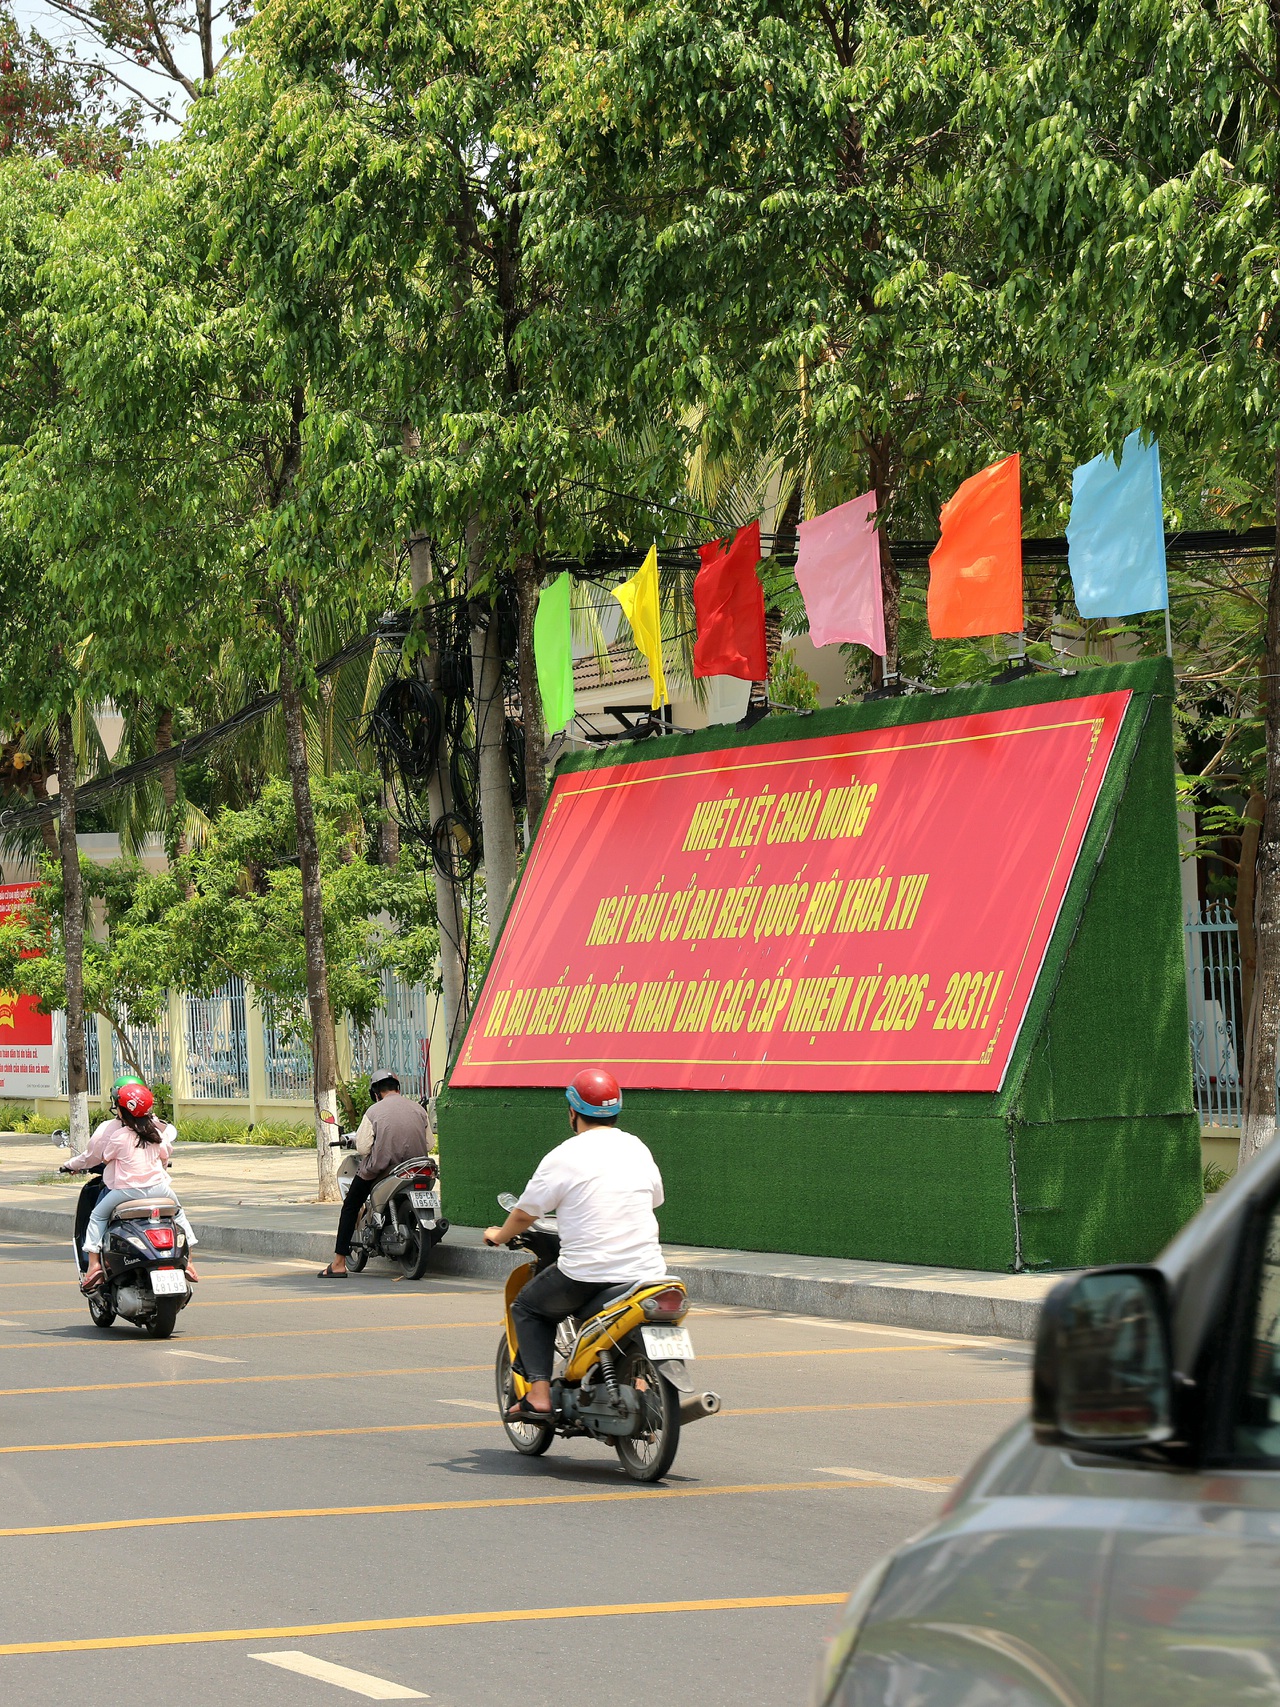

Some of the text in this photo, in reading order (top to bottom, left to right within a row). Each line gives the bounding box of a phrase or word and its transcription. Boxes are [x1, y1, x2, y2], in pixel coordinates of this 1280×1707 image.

[681, 775, 878, 861] NHIỆT LIỆT CHÀO MỪNG
[585, 885, 635, 946] NGÀY
[625, 875, 669, 943] BẦU
[659, 873, 697, 941] CỬ
[682, 888, 722, 951] ĐẠI
[712, 864, 763, 938] BIỂU
[754, 864, 810, 943] QUỐC
[799, 868, 843, 946] HỘI
[883, 873, 929, 931] XVI
[483, 959, 1004, 1047] VÀ ĐẠI BIỂU HỘI ĐỒNG NHÂN DÂN CÁC CẤP NHIỆM KỲ 2026 - 2031!
